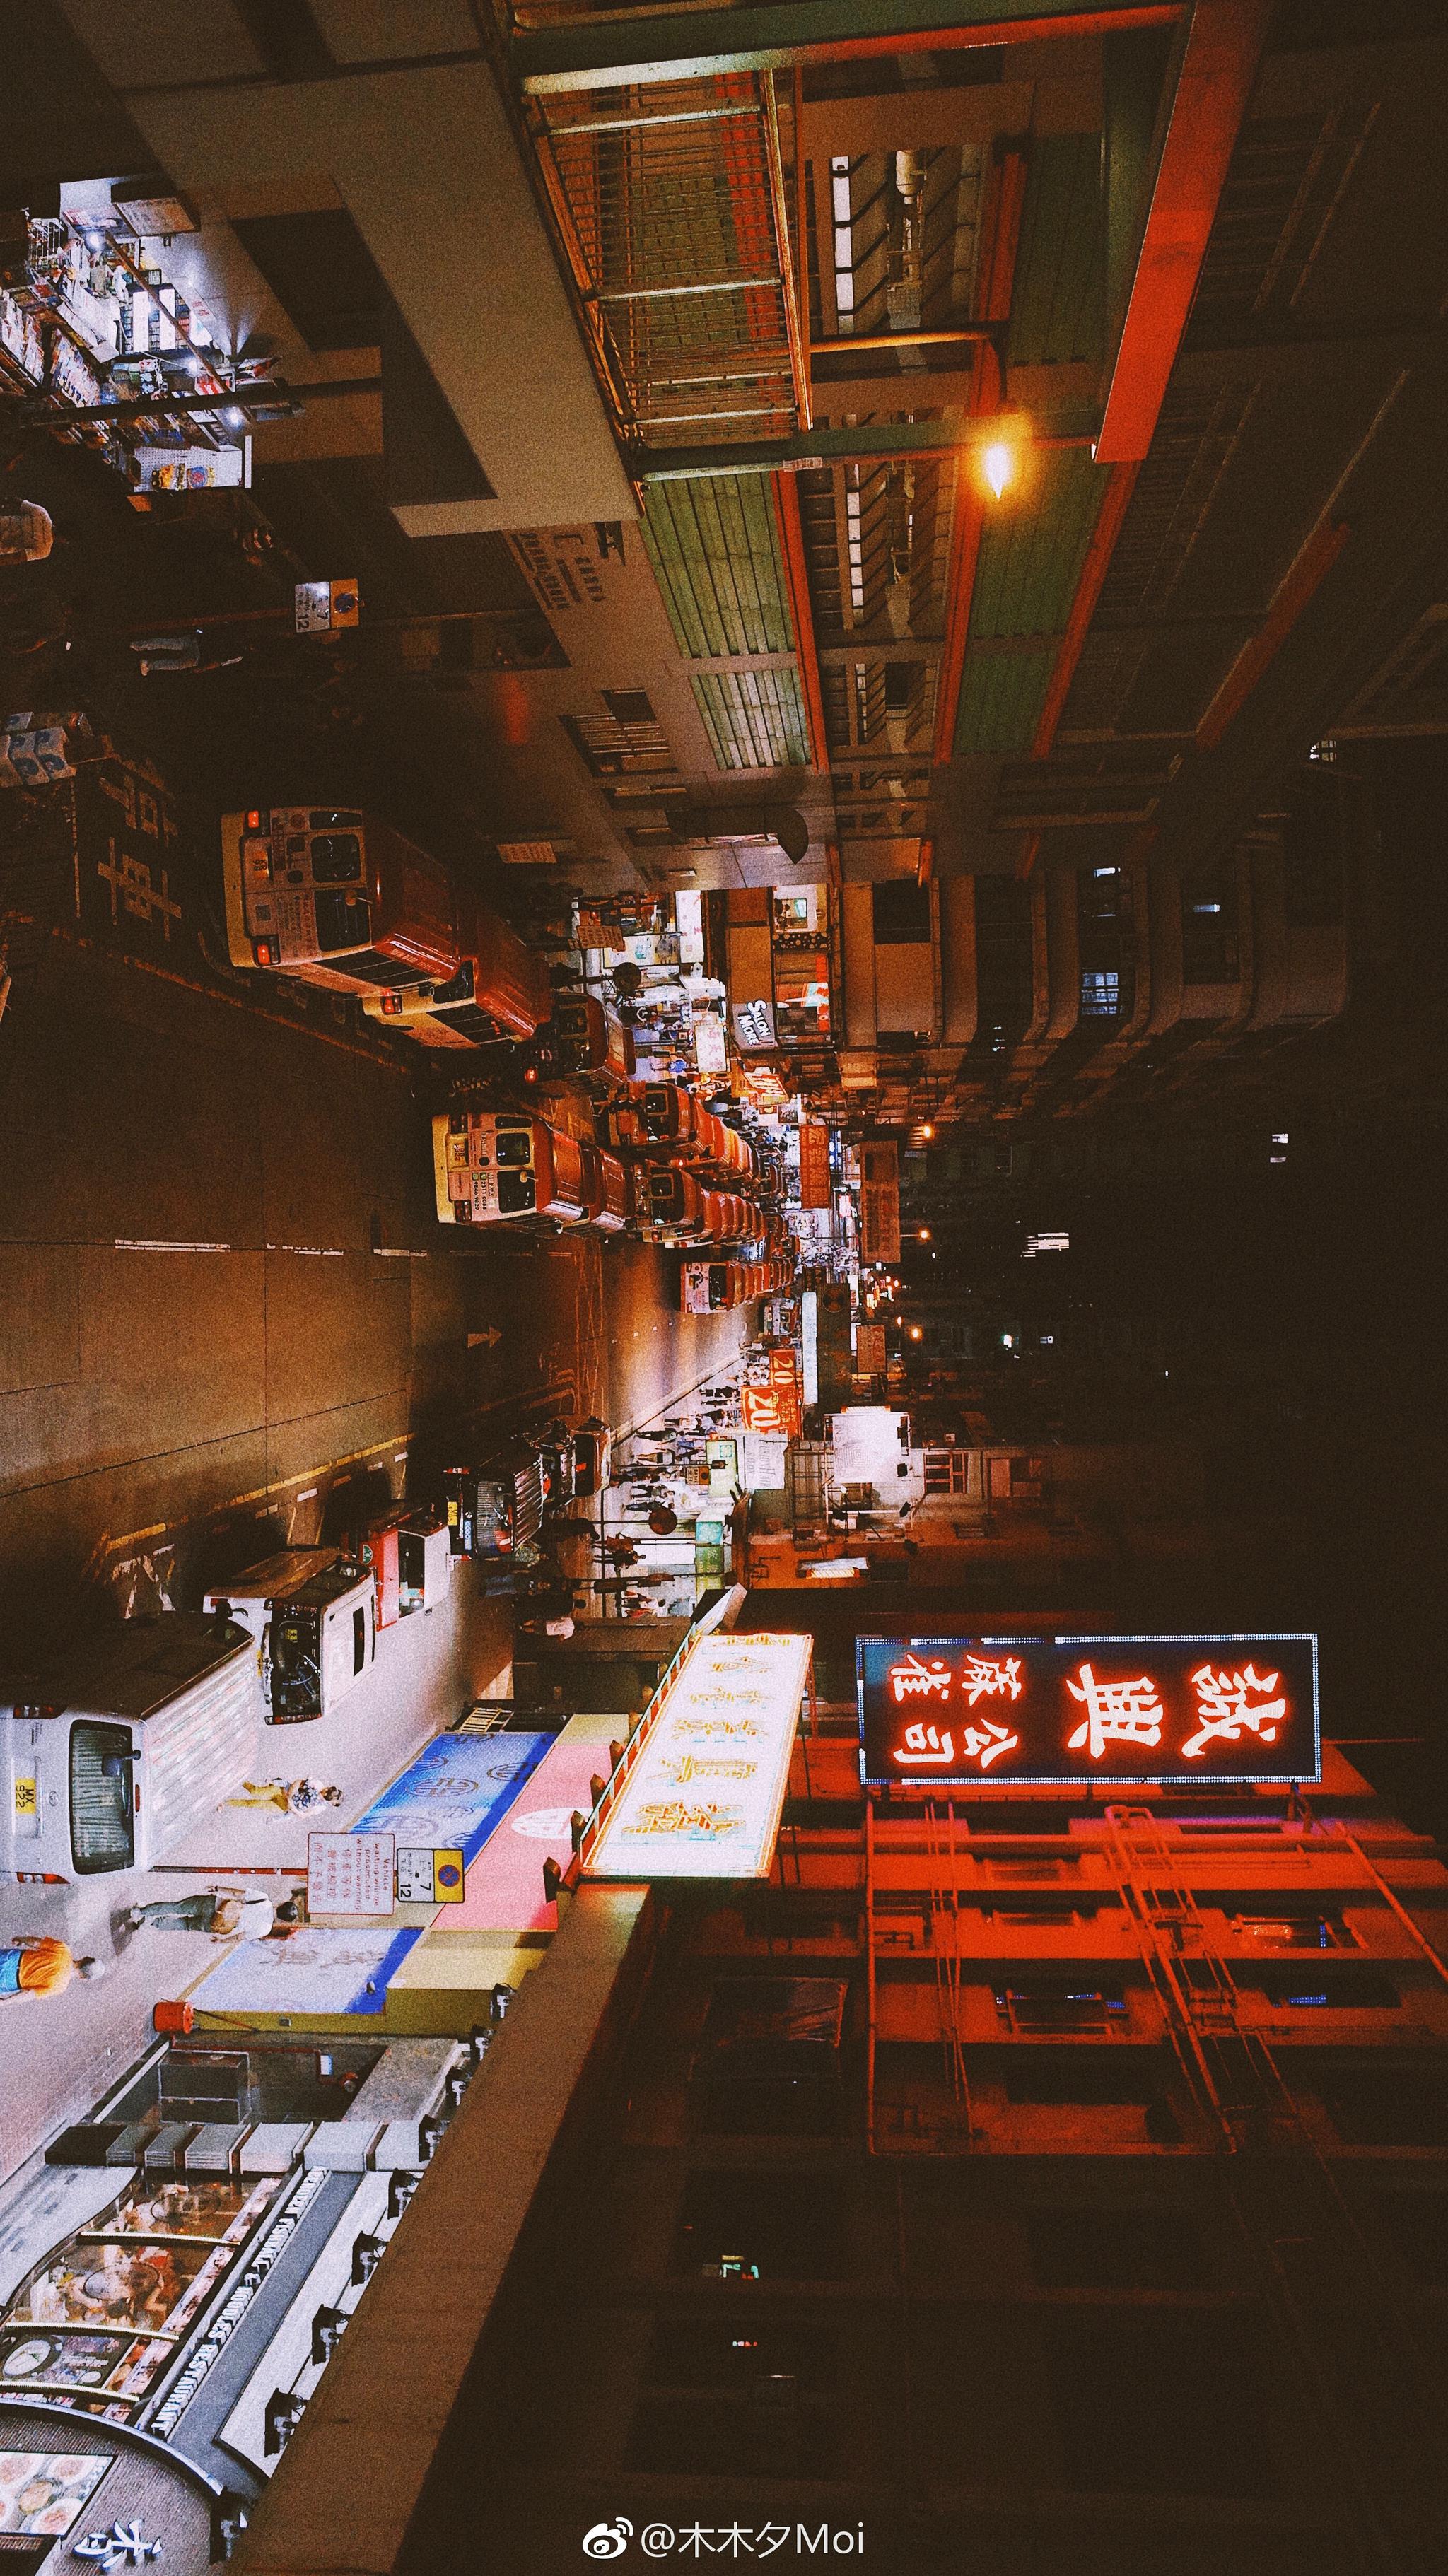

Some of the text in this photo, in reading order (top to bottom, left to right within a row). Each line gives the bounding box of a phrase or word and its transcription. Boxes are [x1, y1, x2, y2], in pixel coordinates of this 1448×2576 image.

[297, 614, 309, 630] 12
[316, 611, 328, 620] 7
[97, 758, 182, 942] 停車
[737, 1014, 759, 1046] MORE
[747, 1000, 771, 1037] SALON
[773, 1357, 795, 1385] 20
[748, 1391, 781, 1427] 20
[1065, 1663, 1286, 1759] 誠興
[892, 1719, 1019, 1769] 公司
[16, 1784, 25, 1808] 922
[25, 1788, 34, 1803] MX
[374, 1896, 380, 1907] be
[400, 1883, 411, 1898] 12
[419, 1883, 431, 1891] 7
[150, 2165, 328, 2437] ABERDEEN FISHBALL & NOODLES RESTAURANT
[71, 2519, 163, 2570] 香
